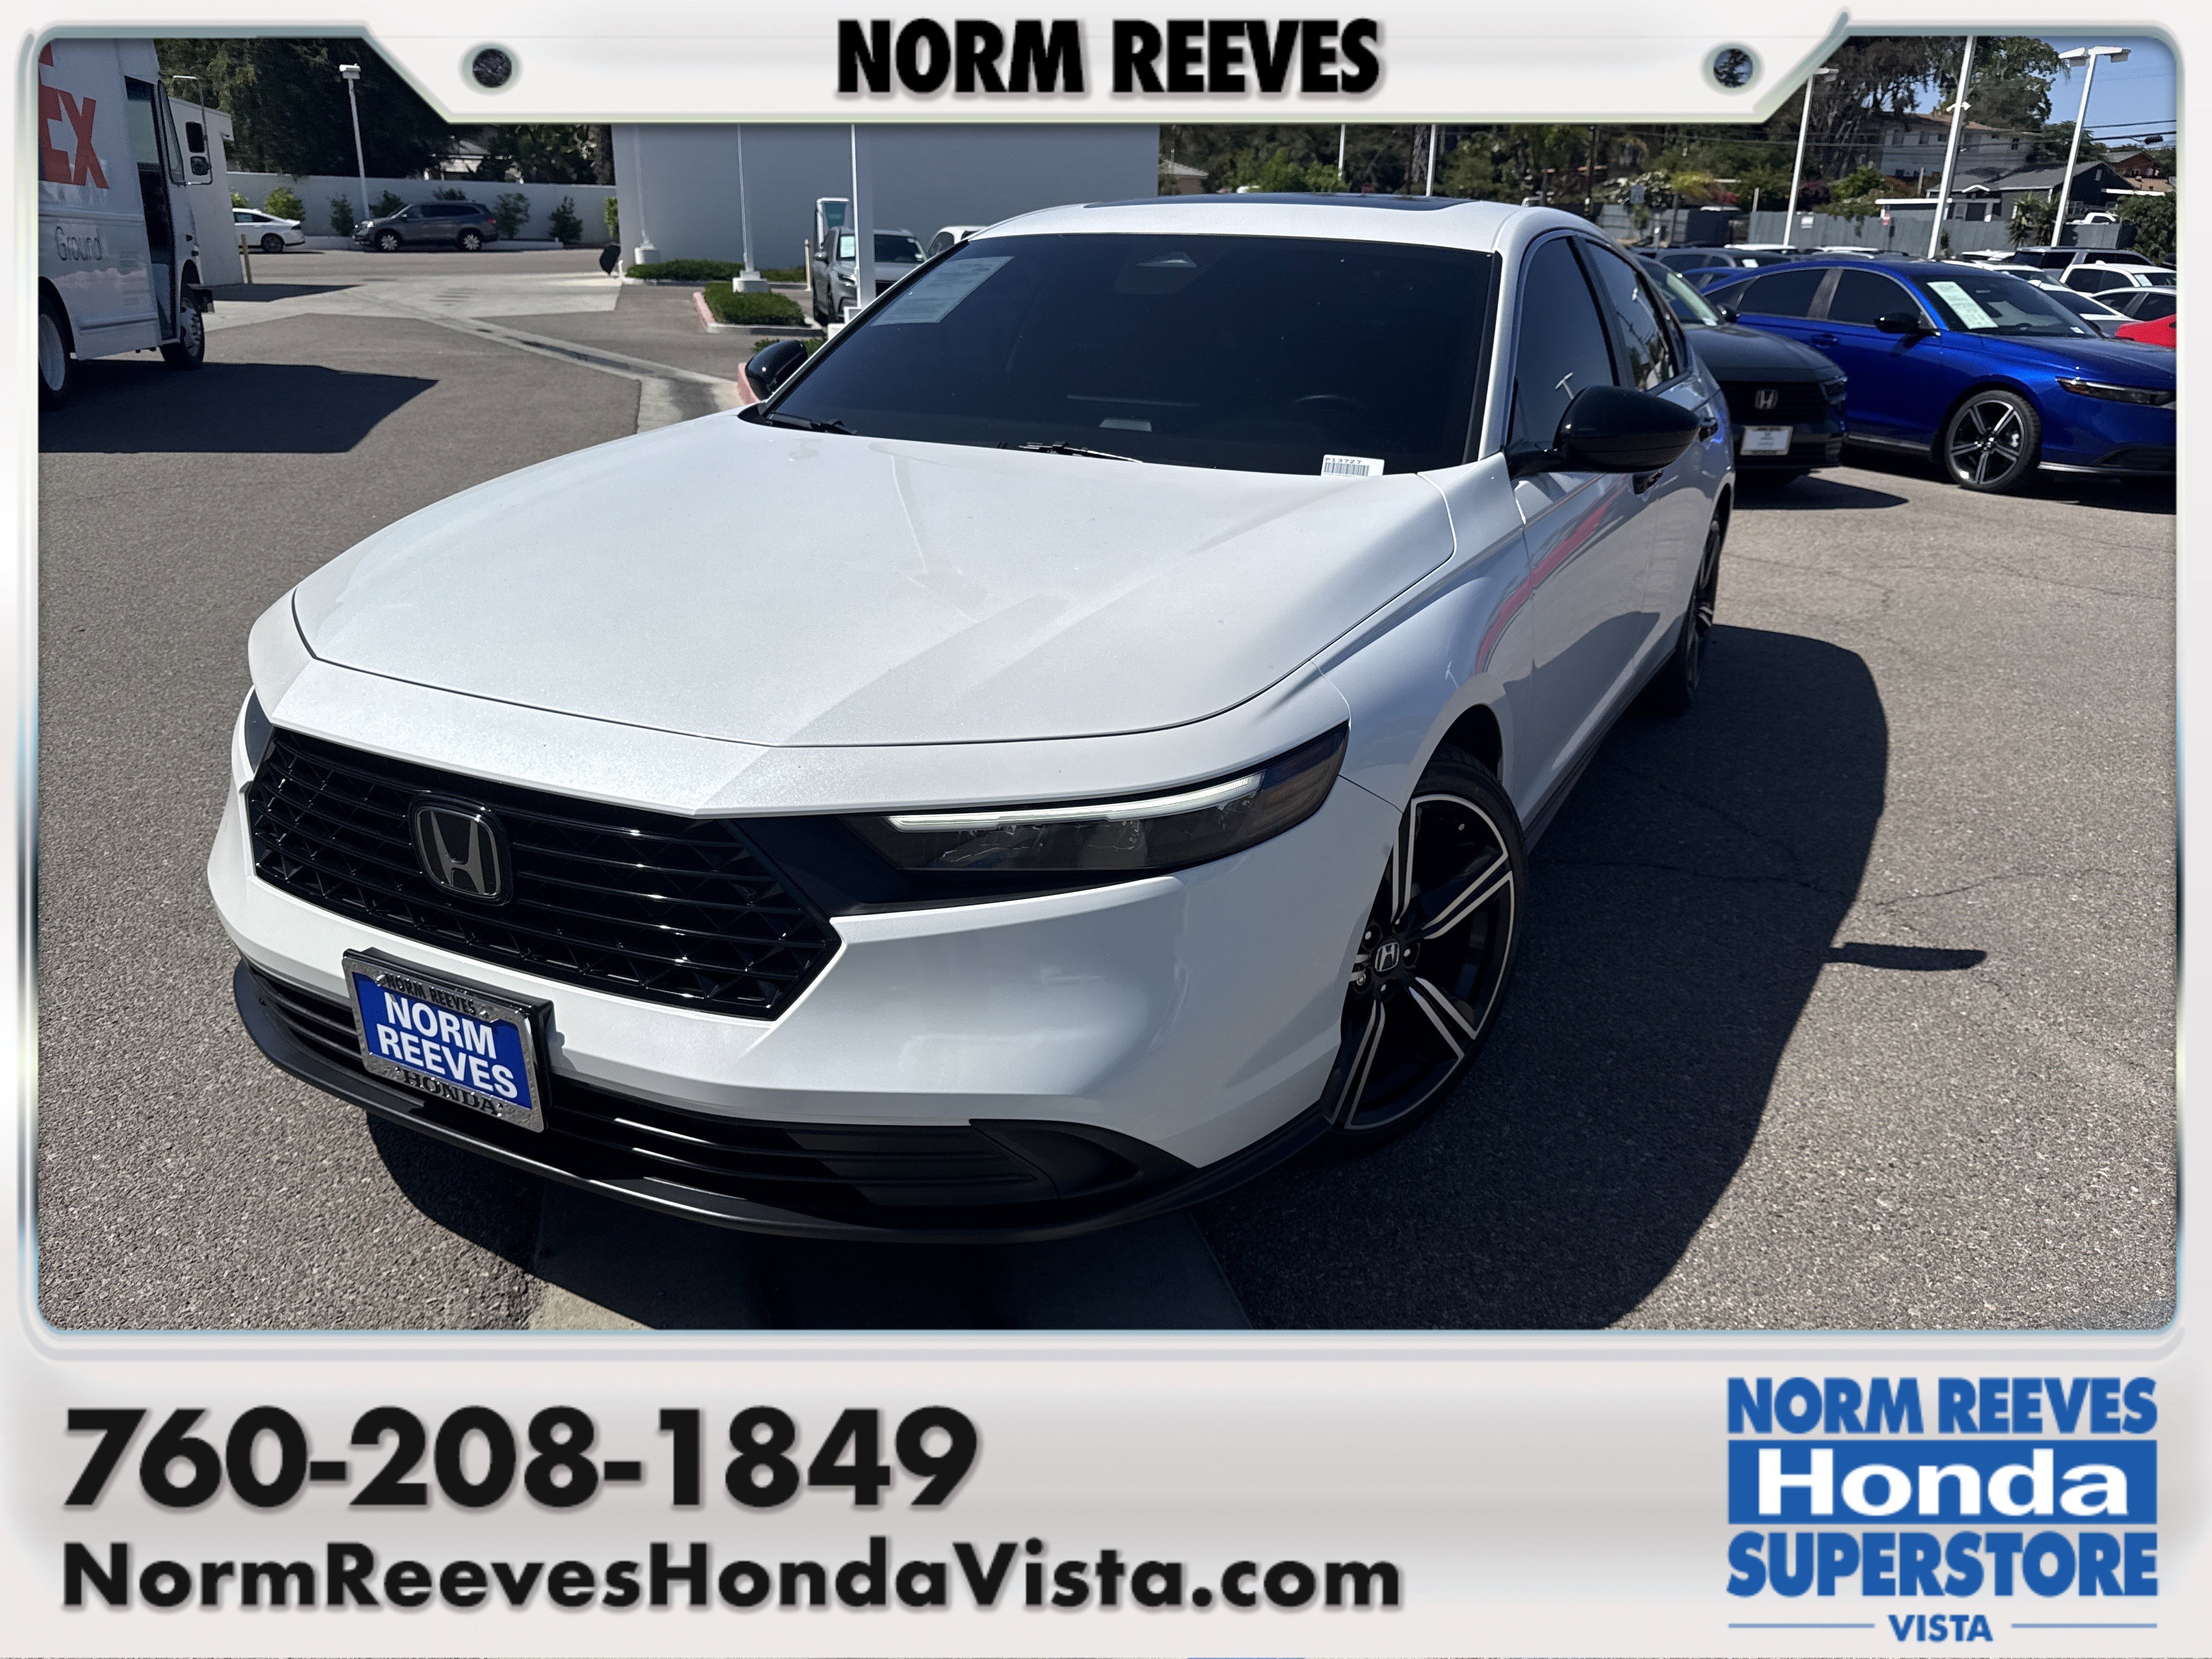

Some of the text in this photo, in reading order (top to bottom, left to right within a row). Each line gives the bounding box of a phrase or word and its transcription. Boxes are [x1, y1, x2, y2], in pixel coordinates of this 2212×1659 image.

[55, 225, 103, 262] Ground
[385, 971, 477, 1015] NORM REEVES
[384, 991, 497, 1060] NORM
[376, 1023, 518, 1099] REEVES
[404, 1071, 500, 1116] HONDA
